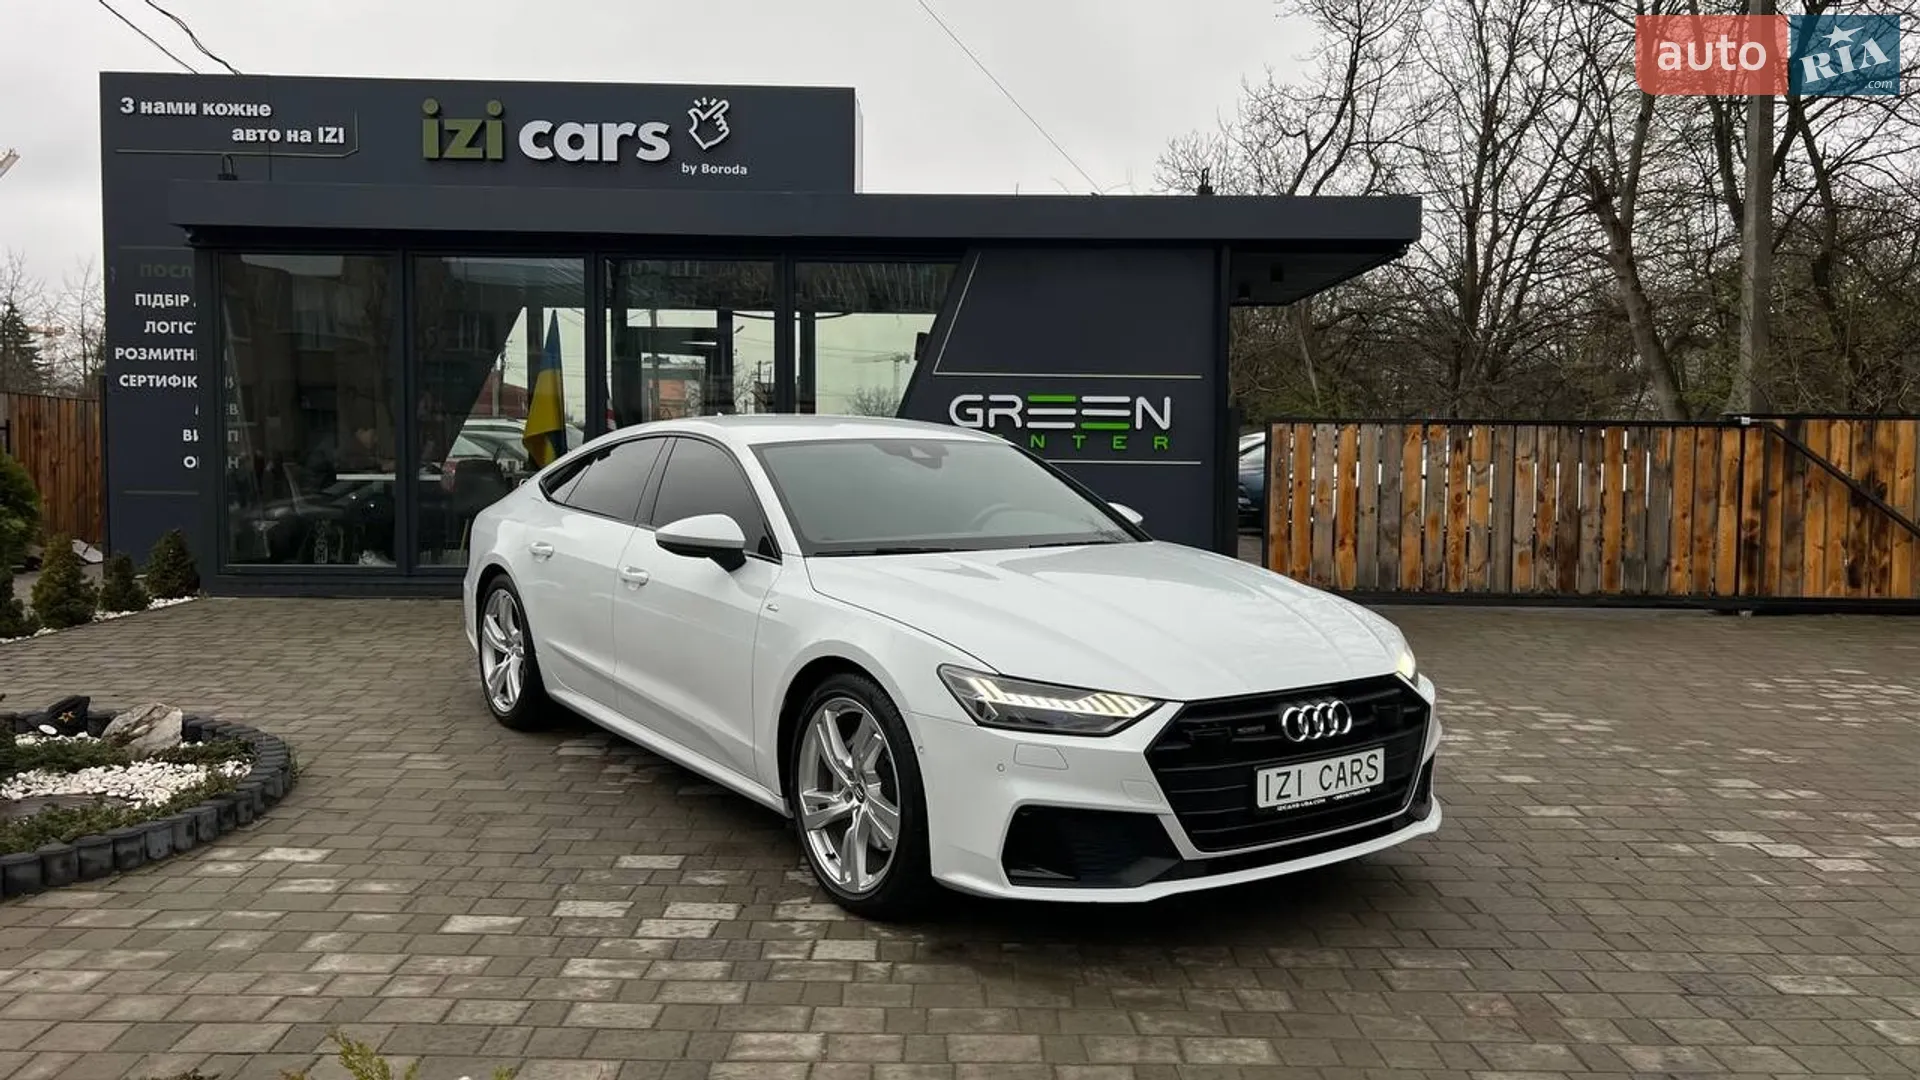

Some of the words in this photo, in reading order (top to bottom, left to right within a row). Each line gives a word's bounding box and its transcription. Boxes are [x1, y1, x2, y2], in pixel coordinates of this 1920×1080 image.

[120, 97, 135, 114] З
[140, 100, 197, 115] нами
[203, 102, 272, 117] кожне
[232, 128, 281, 142] авто
[286, 129, 312, 143] на
[317, 127, 345, 143] IZI
[422, 98, 504, 160] izi
[518, 119, 671, 162] cars
[681, 163, 698, 175] by
[701, 163, 748, 175] Boroda
[140, 263, 193, 279] ПОСЛ
[134, 293, 191, 308] ПІДБІР
[144, 320, 197, 334] ЛОГІС
[114, 347, 197, 361] РОЗМИТН
[118, 374, 198, 388] СЕРТИФІК
[949, 394, 1172, 430] GREEN
[995, 434, 1169, 450] NTER
[1264, 769, 1302, 802] IZI
[1319, 753, 1378, 791] CARS
